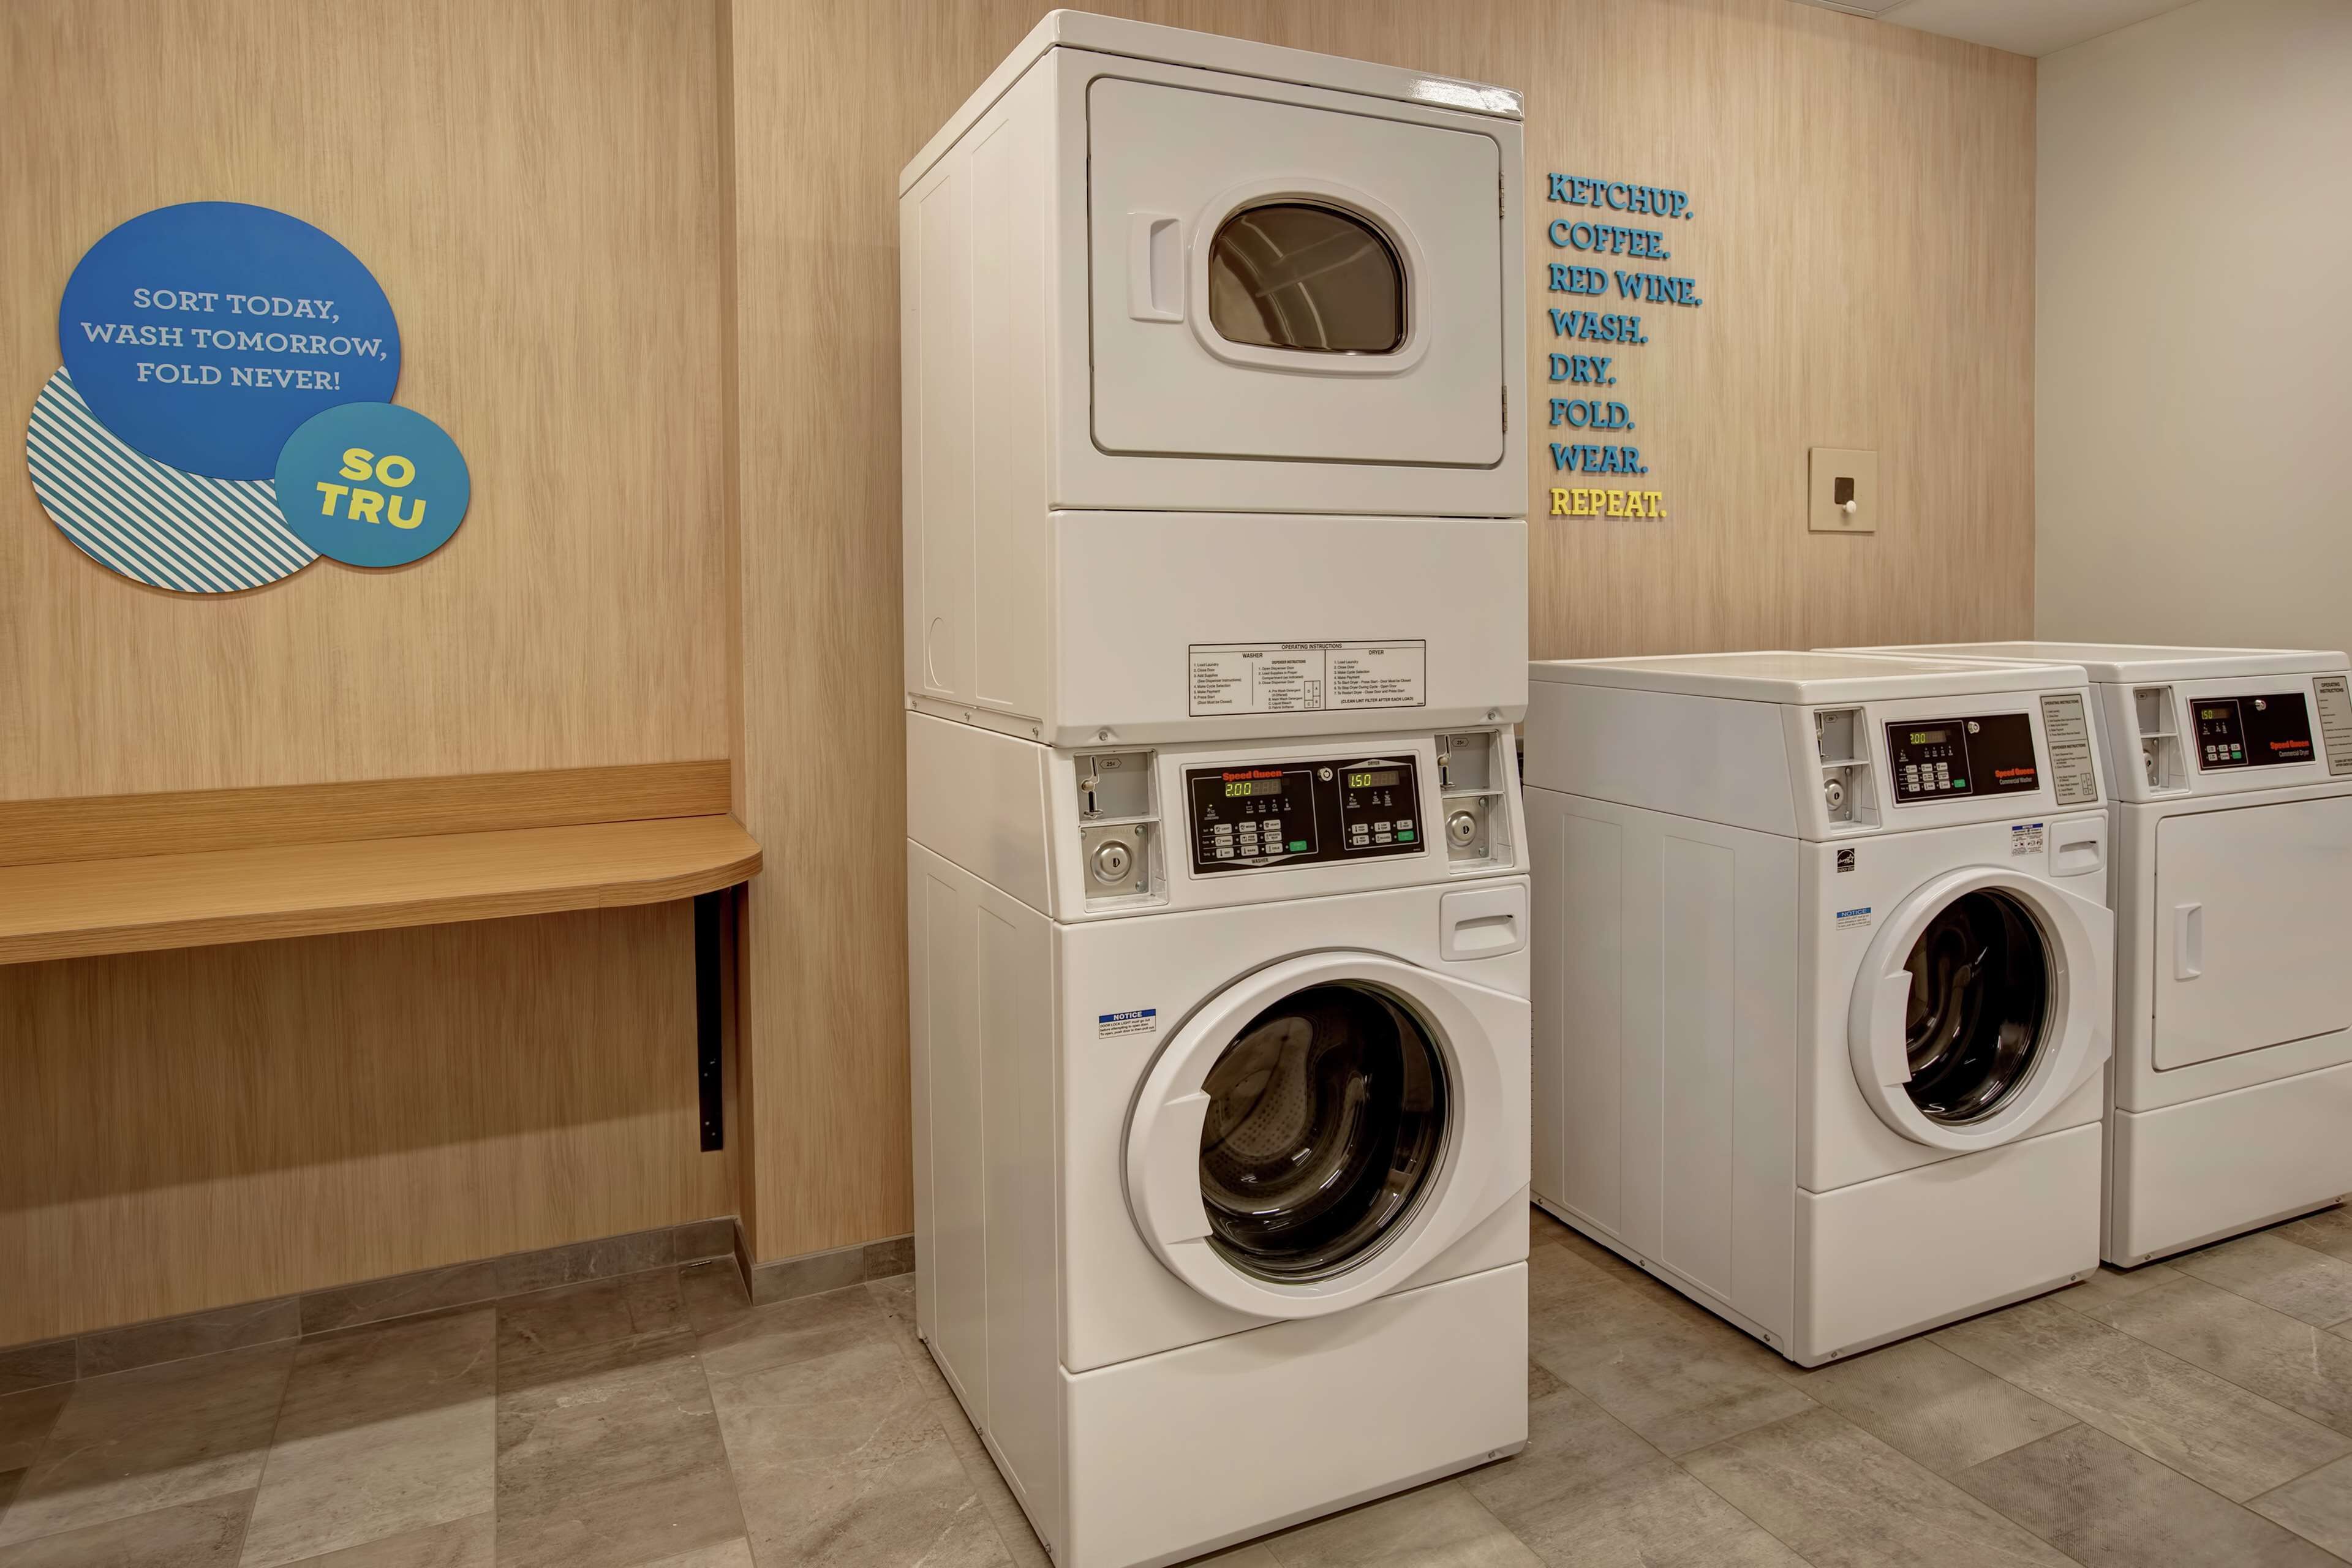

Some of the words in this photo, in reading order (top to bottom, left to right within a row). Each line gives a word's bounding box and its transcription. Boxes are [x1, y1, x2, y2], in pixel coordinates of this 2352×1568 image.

[1549, 173, 1694, 219] KETCHUP.
[1549, 219, 1670, 258] COFFEE.
[1549, 263, 1609, 294] RED
[1615, 271, 1702, 305] WINE.
[133, 288, 219, 312] SORT
[225, 294, 339, 324] TODAY,
[80, 322, 184, 347] WASH
[190, 328, 387, 361] TOMORROW,
[1550, 309, 1648, 343] WASH.
[137, 362, 222, 385] FOLD
[230, 366, 340, 391] NEVER!
[1550, 353, 1616, 384] DRY.
[1550, 398, 1635, 429] FOLD.
[339, 448, 416, 488] SO
[1550, 443, 1648, 473] WEAR.
[316, 481, 426, 530] TRU
[1550, 488, 1667, 518] REPEAT.
[2270, 741, 2290, 750] Speed
[1223, 772, 1252, 781] Speed
[1995, 769, 2015, 778] Speed
[1225, 783, 1251, 797] 2.00
[1114, 1011, 1142, 1020] NOTICE
